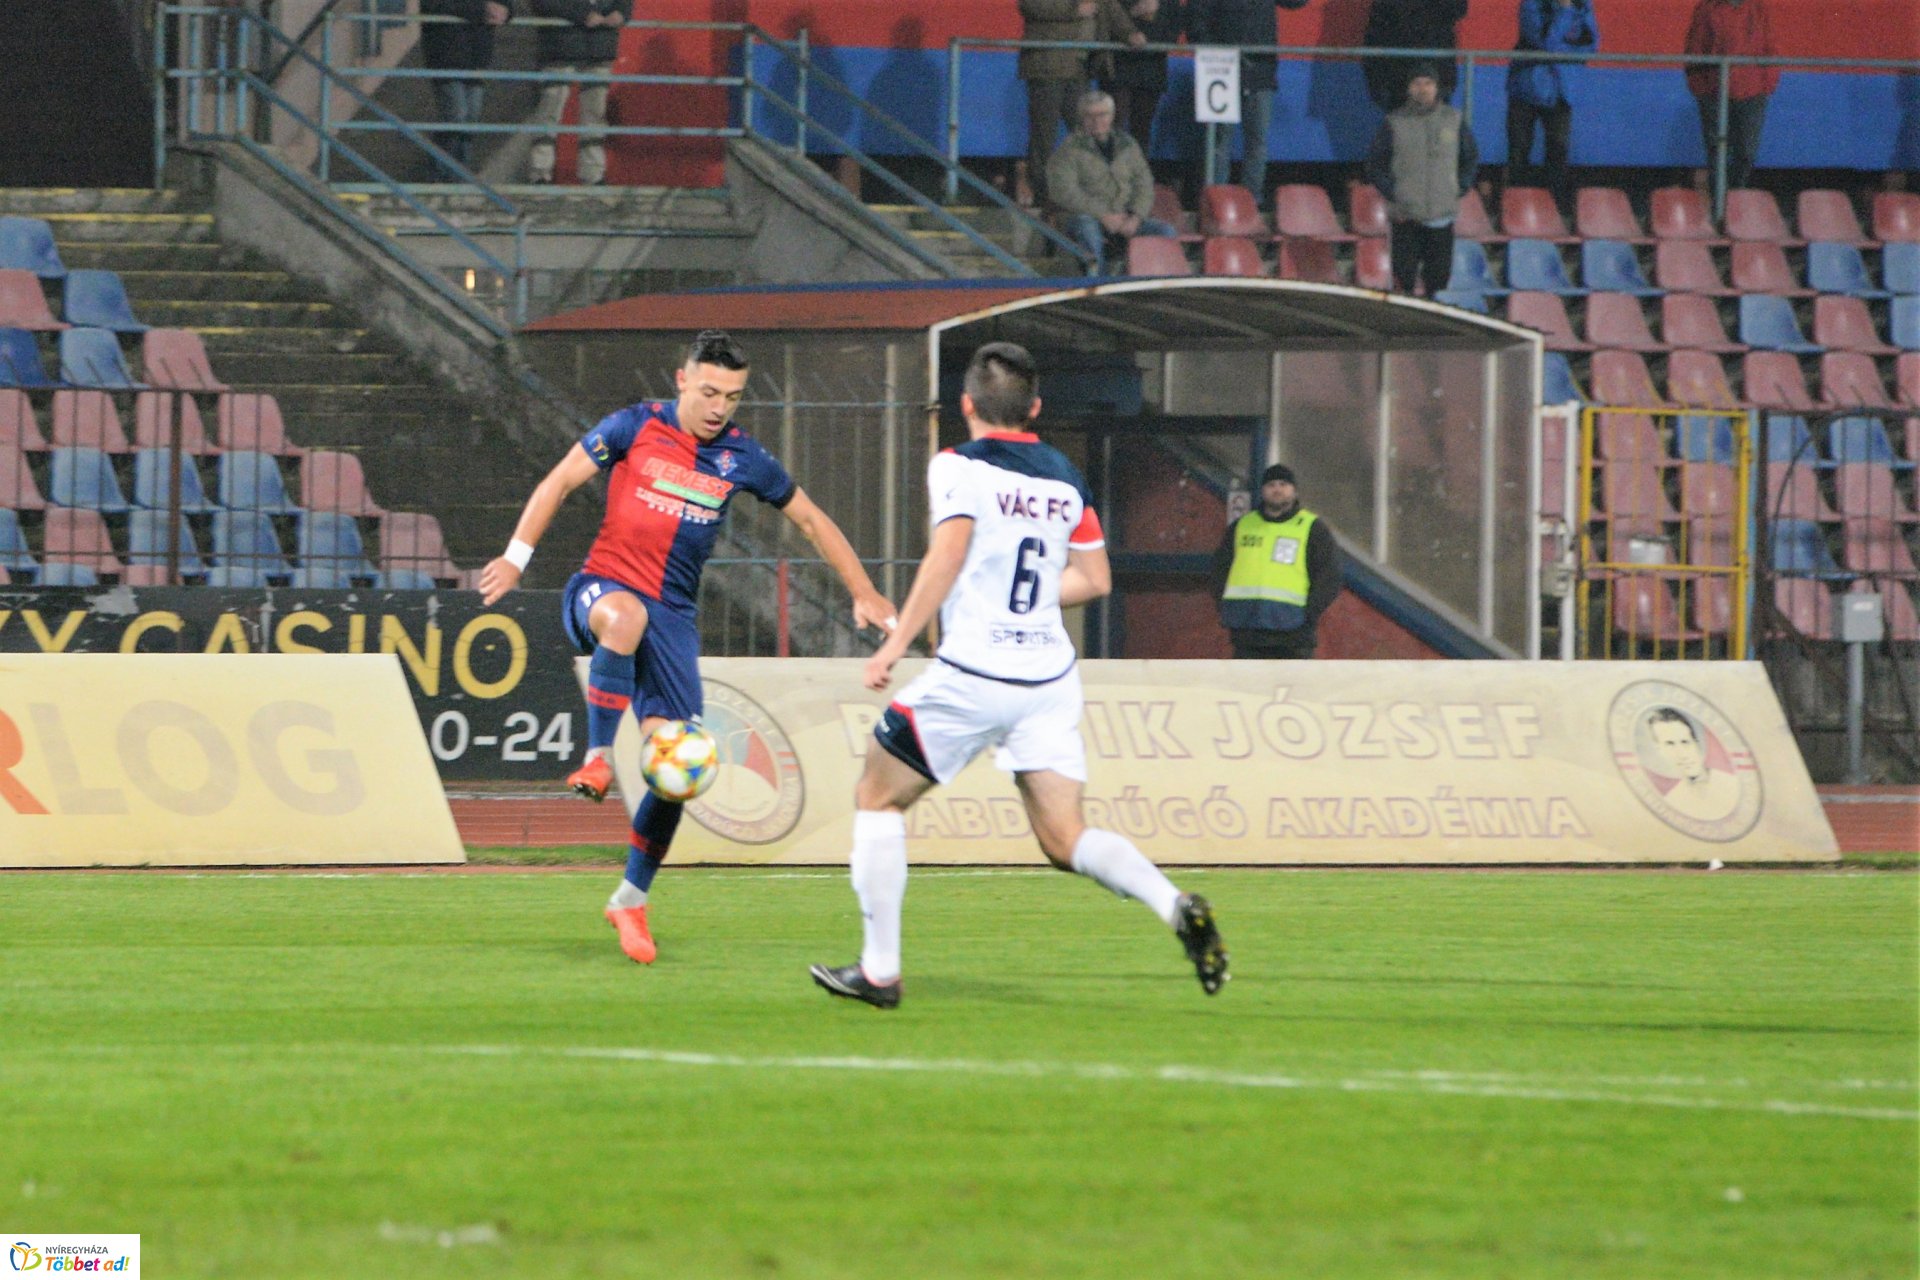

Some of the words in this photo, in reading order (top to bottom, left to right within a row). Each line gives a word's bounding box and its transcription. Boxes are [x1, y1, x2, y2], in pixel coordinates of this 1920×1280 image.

[1208, 80, 1228, 114] C
[997, 489, 1040, 518] VÁC
[1047, 499, 1072, 522] FC
[1009, 537, 1045, 614] 6
[431, 710, 574, 762] 0-24
[1212, 686, 1542, 760] JÓZSEF
[1266, 786, 1594, 840] AKADÉMIA
